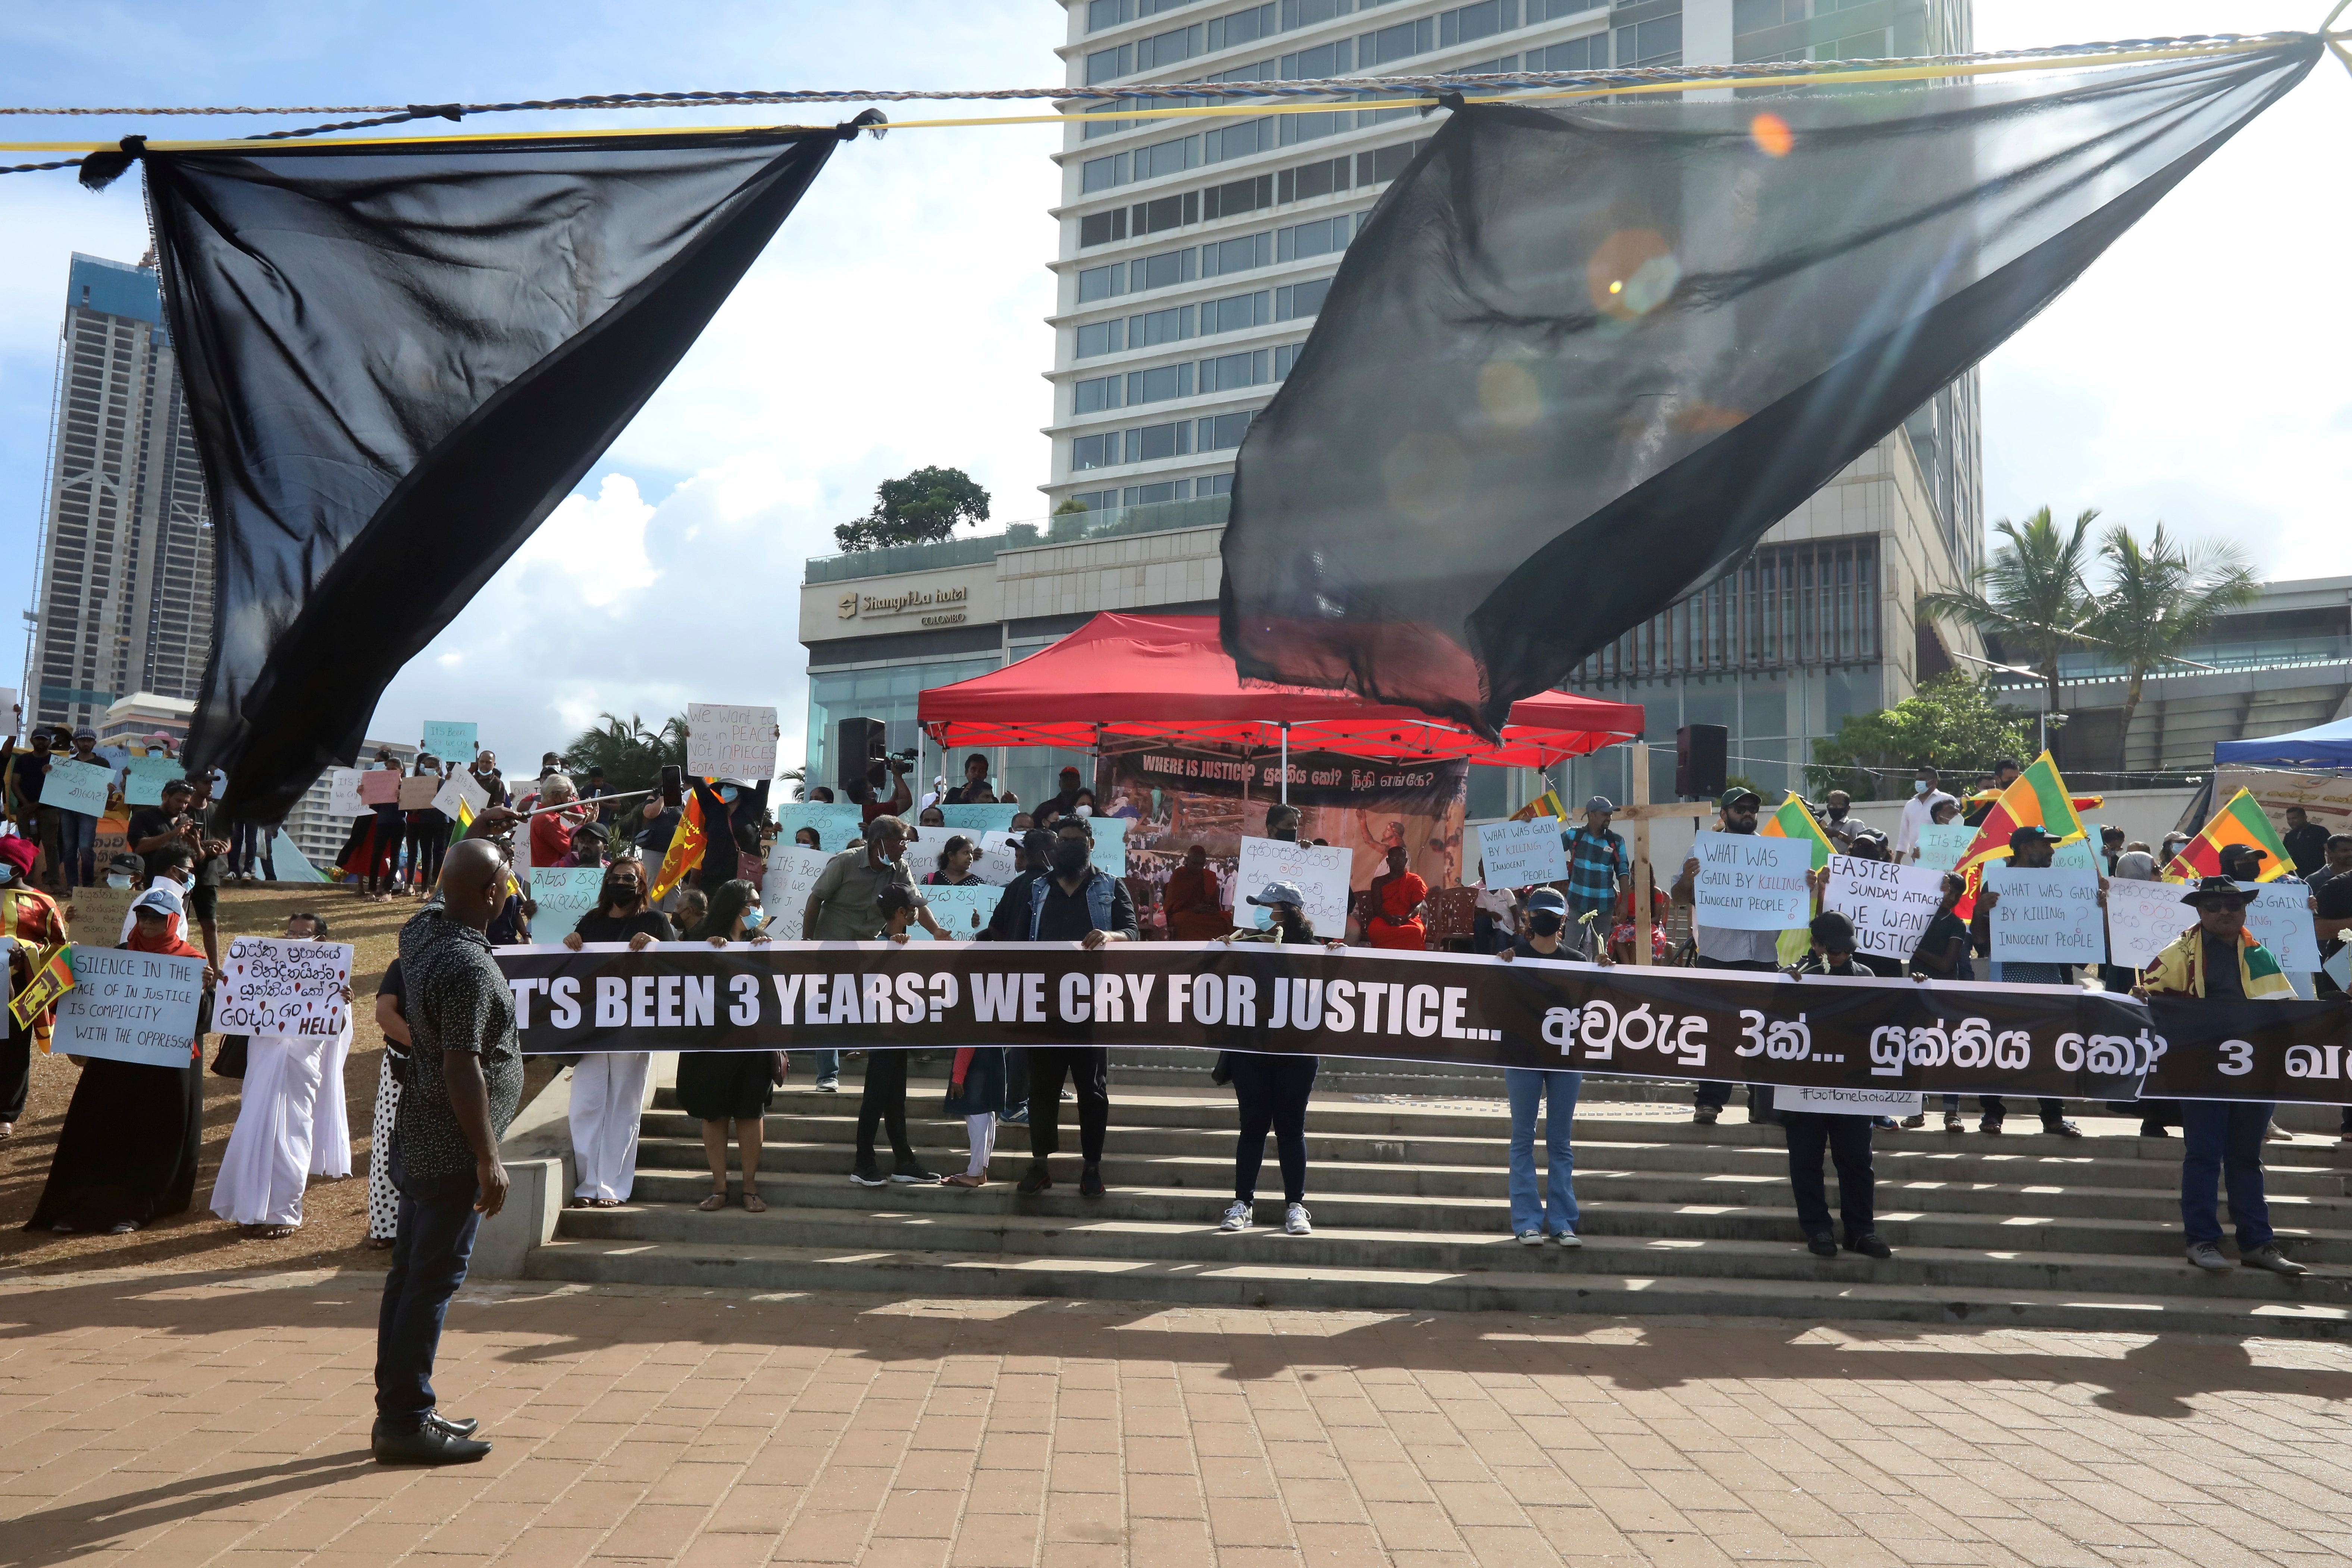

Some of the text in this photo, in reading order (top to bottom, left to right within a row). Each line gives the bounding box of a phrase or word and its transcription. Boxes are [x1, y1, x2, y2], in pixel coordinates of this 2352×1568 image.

[935, 586, 967, 602] hotel
[921, 613, 966, 625] COLOMBO
[760, 711, 776, 725] to
[716, 732, 727, 741] in
[732, 725, 777, 742] PEACE
[719, 742, 732, 760] in
[734, 744, 776, 759] PIECES
[689, 761, 773, 776] GOTA GO HOME
[1143, 754, 1184, 775] WHERE
[1186, 760, 1198, 776] IS
[1093, 827, 1103, 836] the
[1484, 823, 1555, 842] WHAT WAS GAIN
[1488, 846, 1500, 856] BY
[1506, 841, 1541, 855] KILLING
[1704, 844, 1778, 867] WHAT WAS
[798, 860, 823, 877] Bee
[1280, 863, 1303, 876] මරා
[1521, 869, 1554, 881] PEOPLE
[1832, 857, 1900, 884] EASTER
[1701, 870, 1804, 892] GAIN BY KILLING
[2000, 883, 2098, 900] WHAT WAS GAIN
[1748, 896, 1785, 911] PEOPLE
[2267, 895, 2304, 908] GAIN
[2001, 907, 2017, 921] BY
[2023, 907, 2065, 921] KILLING
[2055, 932, 2094, 948] PEOPLE
[73, 955, 191, 982] SILENCE IN THE
[71, 980, 95, 996] FACE
[104, 984, 119, 996] OF
[143, 988, 191, 1004] JUSTICE
[69, 1003, 85, 1015] IS
[509, 972, 1501, 1041] T'S BEEN 3 YEARS? WE CRY FOR JUSTICE...
[280, 1003, 301, 1017] GO
[298, 1017, 337, 1035] HELL
[76, 1026, 194, 1050] WITH THE OPPRESSOR
[1870, 1017, 2030, 1076] යුක්තිය
[2055, 1028, 2167, 1076] කෝ?
[2218, 1040, 2253, 1075] 3
